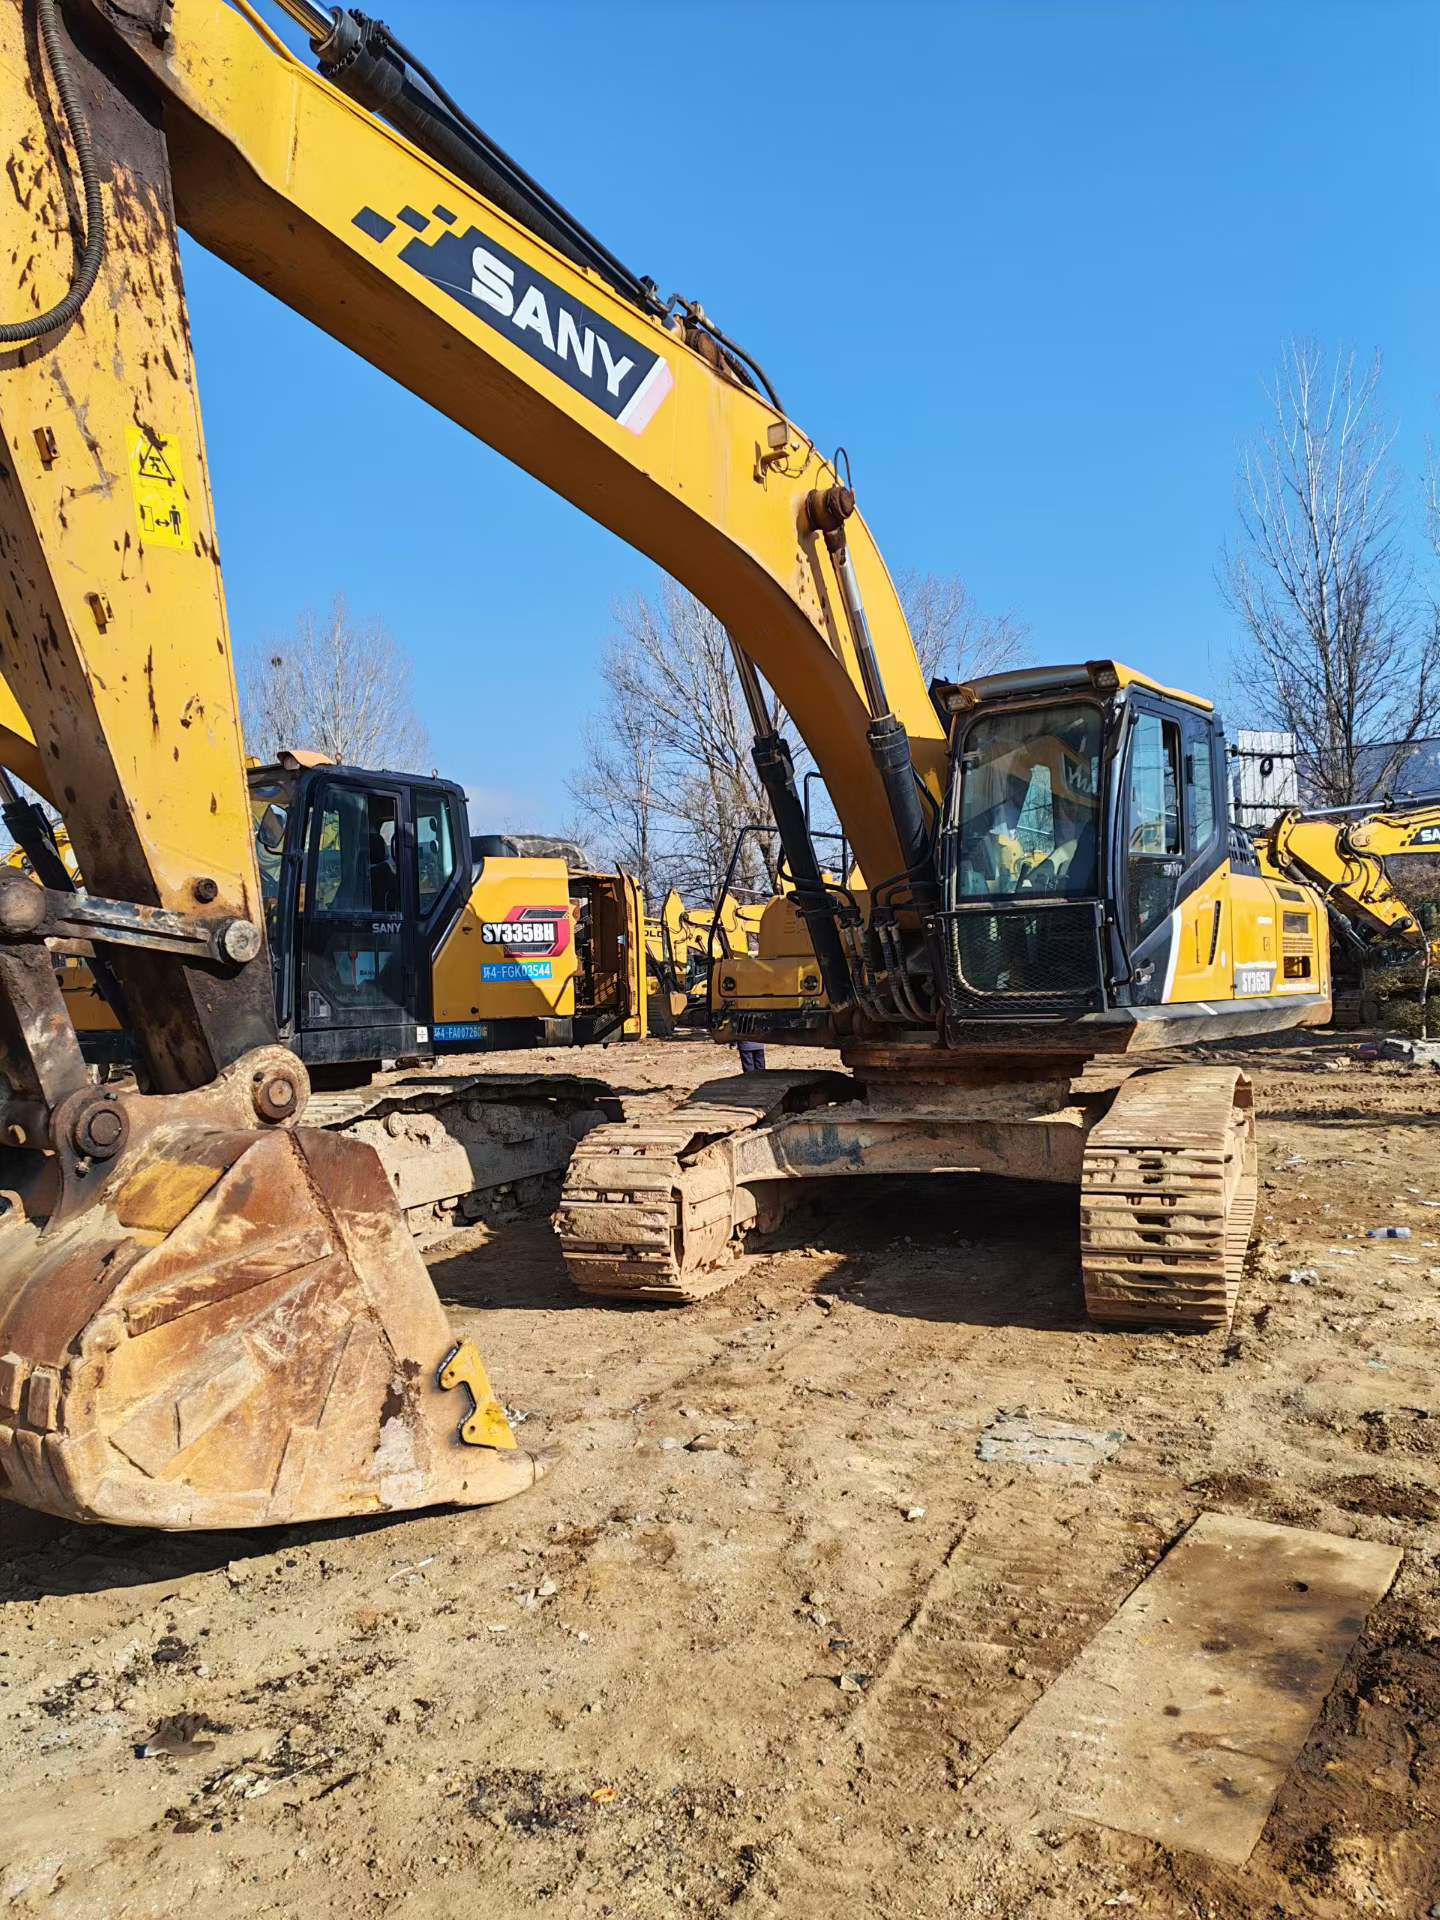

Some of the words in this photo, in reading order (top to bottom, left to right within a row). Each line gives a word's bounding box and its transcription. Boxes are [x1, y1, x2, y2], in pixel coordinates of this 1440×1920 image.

[470, 246, 637, 397] SANY
[371, 922, 402, 934] SANY
[482, 922, 555, 942] SY335BH
